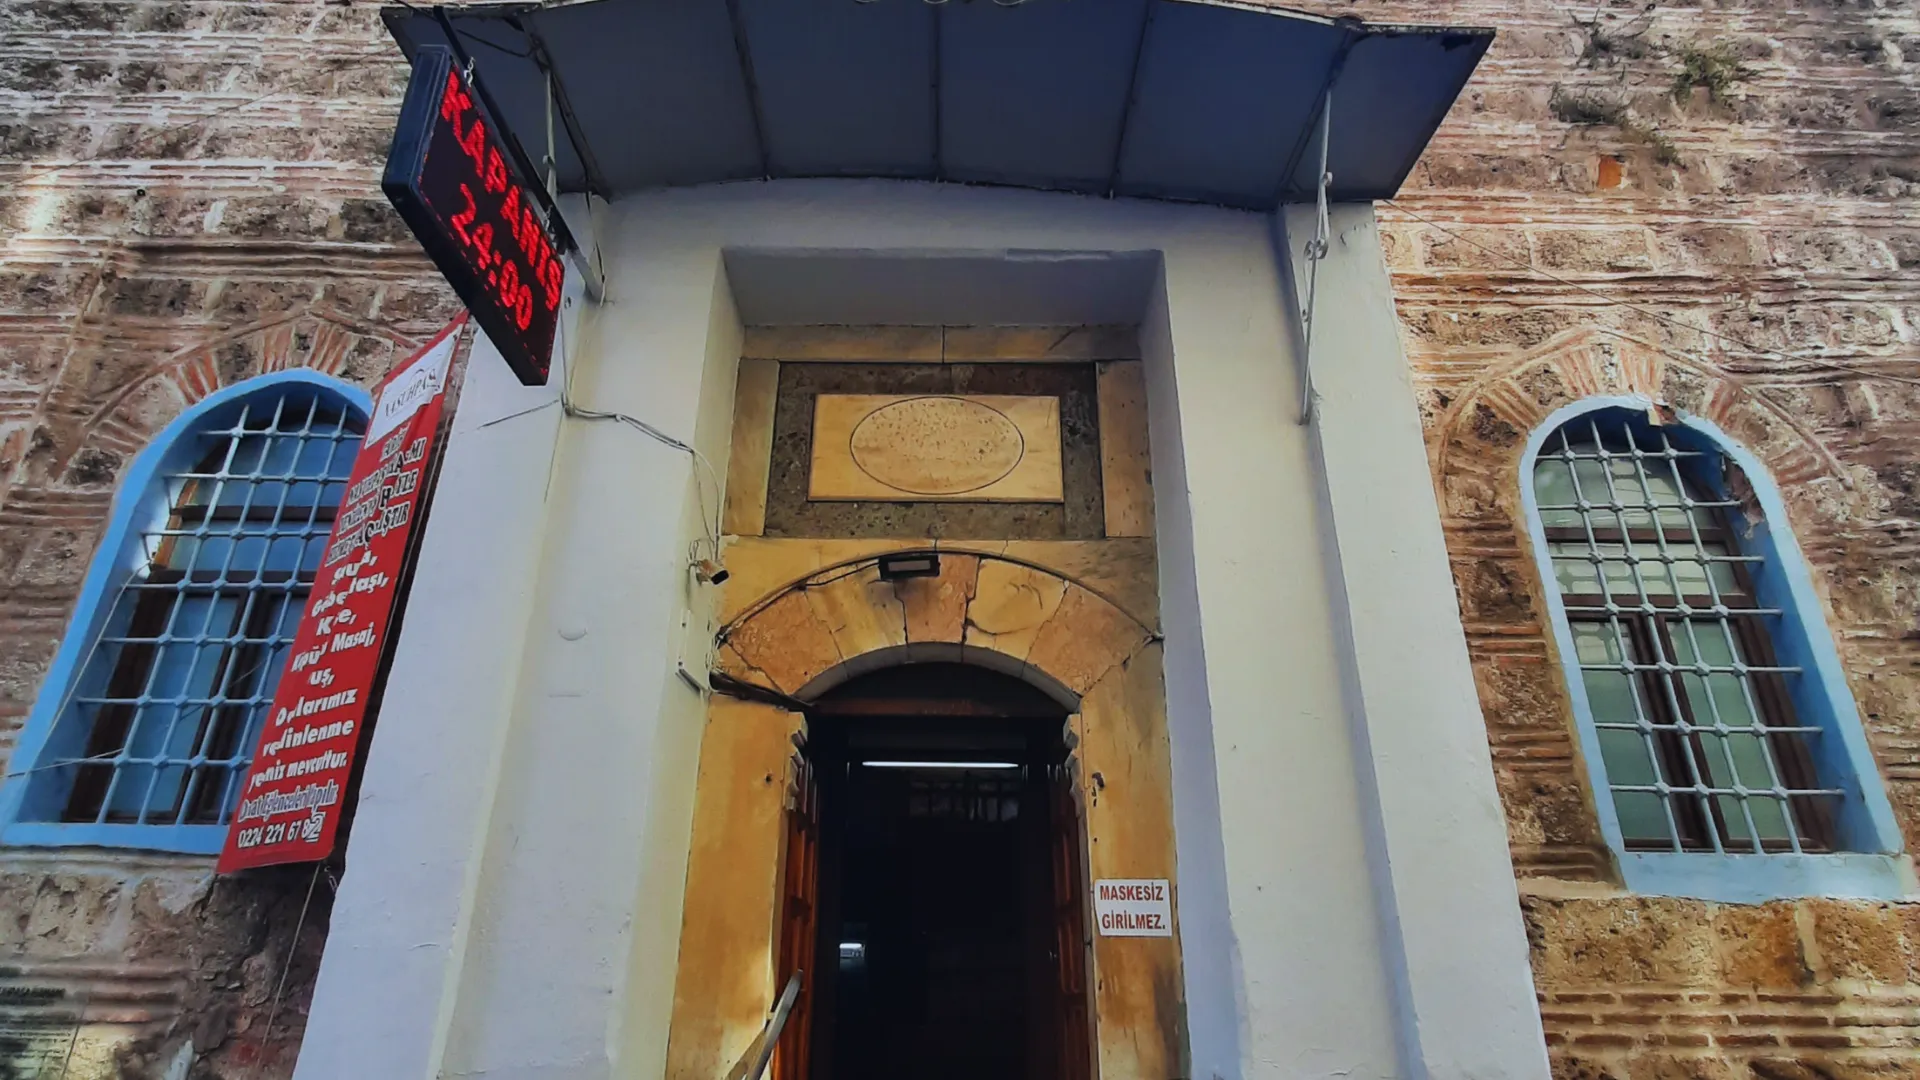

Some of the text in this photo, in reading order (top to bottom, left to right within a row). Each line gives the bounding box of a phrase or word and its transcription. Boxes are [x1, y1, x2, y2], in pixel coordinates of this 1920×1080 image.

[441, 70, 562, 311] KAPANIŞ
[451, 182, 533, 331] 24:00
[238, 826, 264, 848] 0224
[264, 823, 286, 844] 221
[287, 820, 302, 842] 67
[1100, 882, 1164, 901] MASKESİZ
[1102, 909, 1166, 929] GİRİLMEZ.
